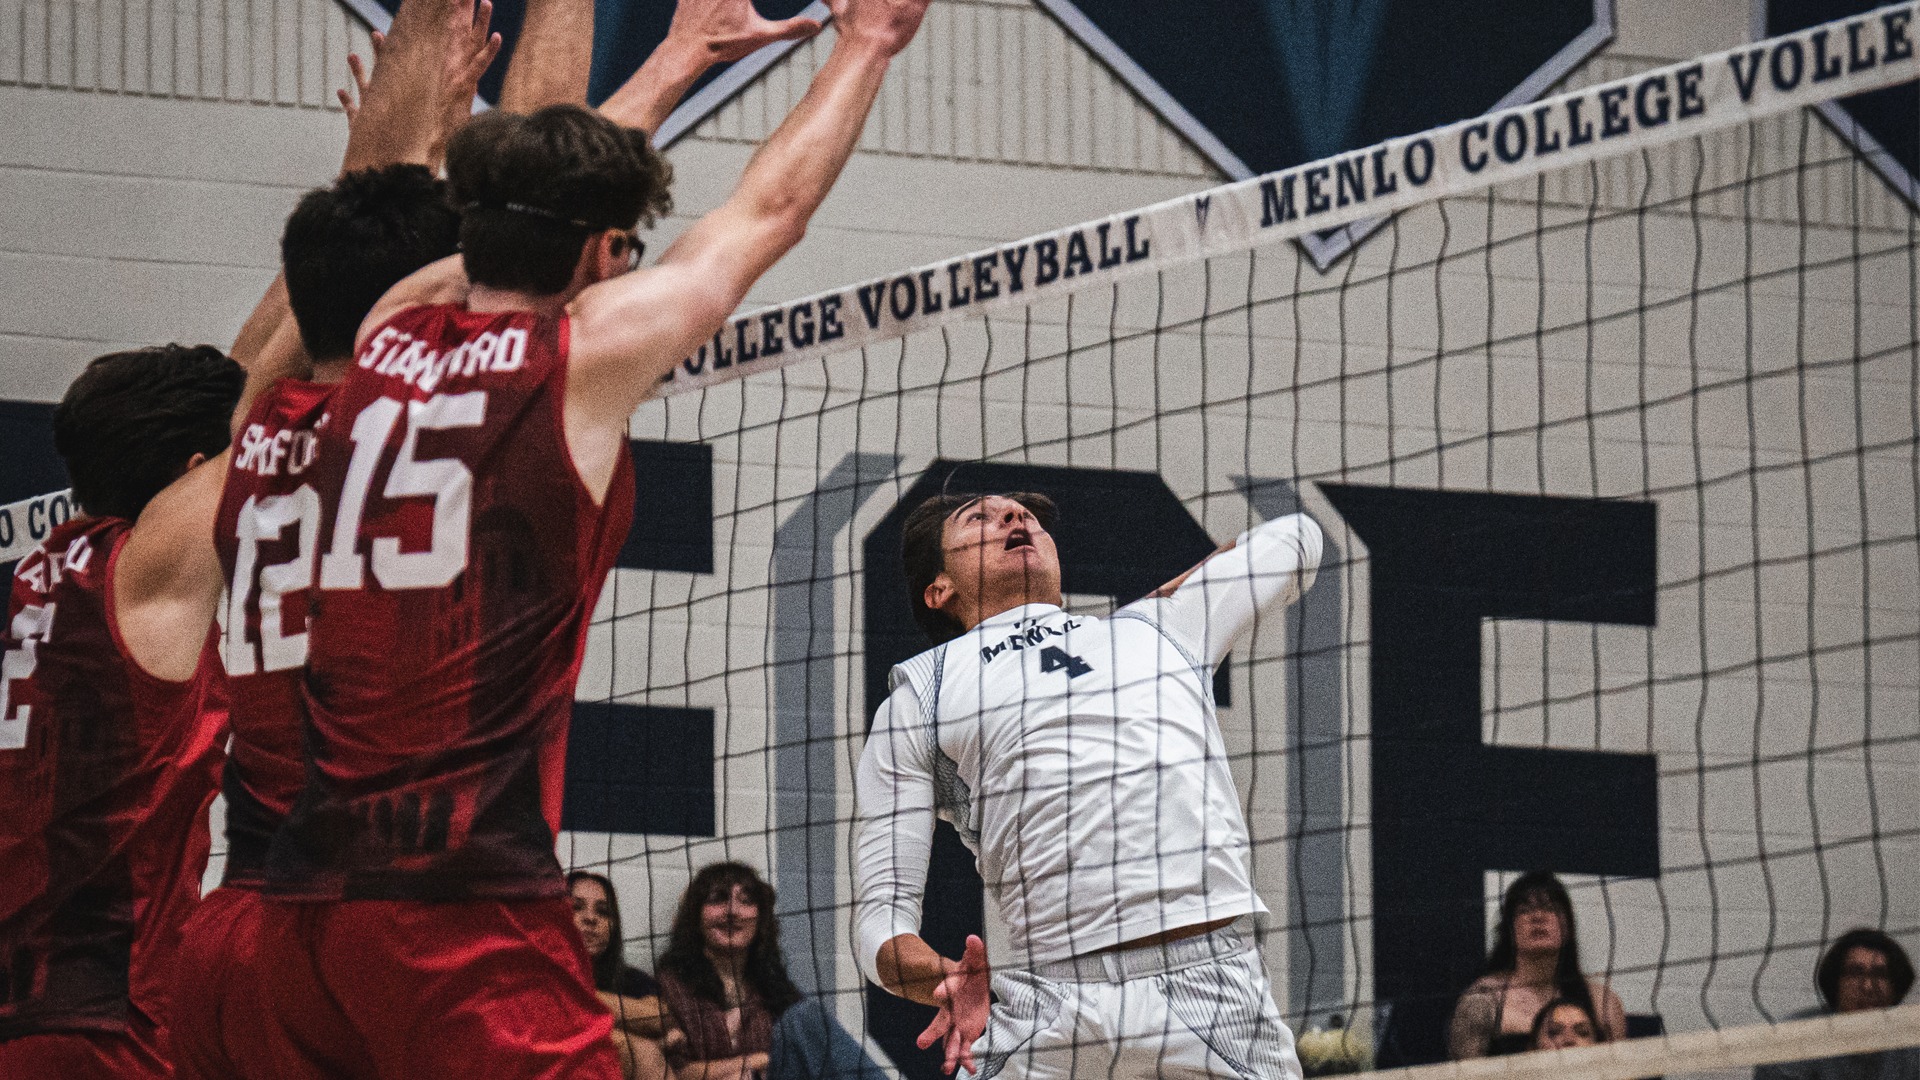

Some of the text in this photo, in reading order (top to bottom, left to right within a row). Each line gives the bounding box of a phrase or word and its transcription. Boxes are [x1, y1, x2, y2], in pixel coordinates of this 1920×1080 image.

[857, 215, 1150, 330] VOLLEYBALL
[1259, 137, 1436, 228] MENLO
[1459, 65, 1706, 174] COLLEGE
[225, 482, 322, 677] 12
[319, 390, 489, 591] 15
[1039, 645, 1094, 680] 4
